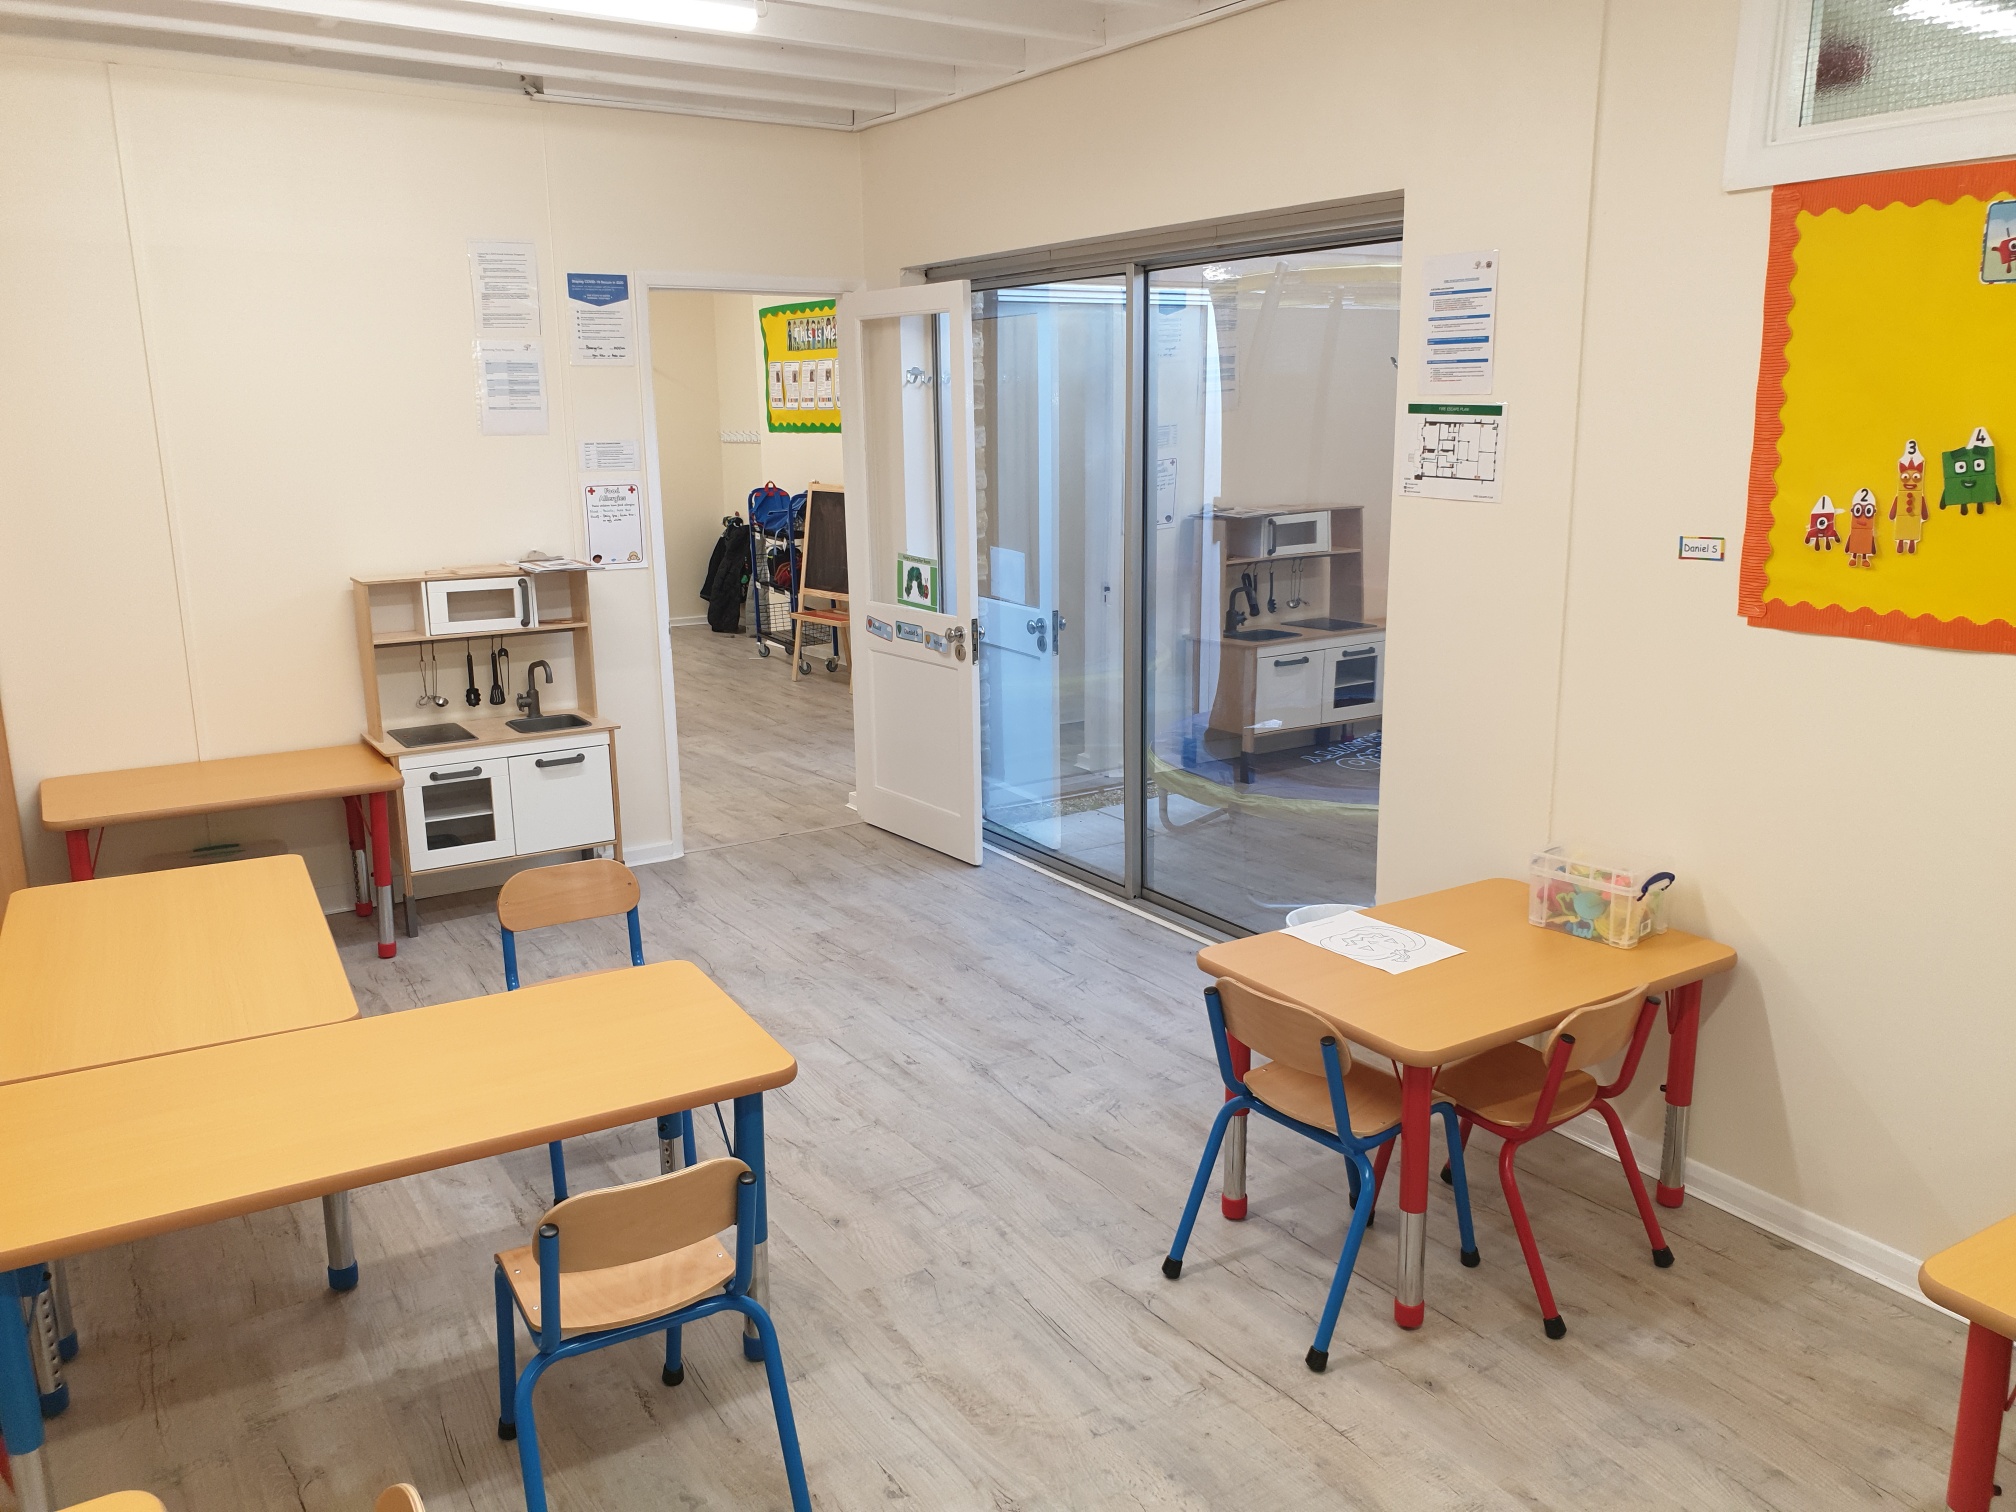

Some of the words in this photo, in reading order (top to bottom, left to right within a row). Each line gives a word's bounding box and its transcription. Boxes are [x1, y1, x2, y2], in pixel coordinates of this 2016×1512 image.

[1975, 428, 1987, 444] 4
[1908, 440, 1917, 455] 3
[1860, 488, 1869, 502] 2
[1683, 543, 1710, 553] Daniel
[1711, 544, 1718, 554] S
